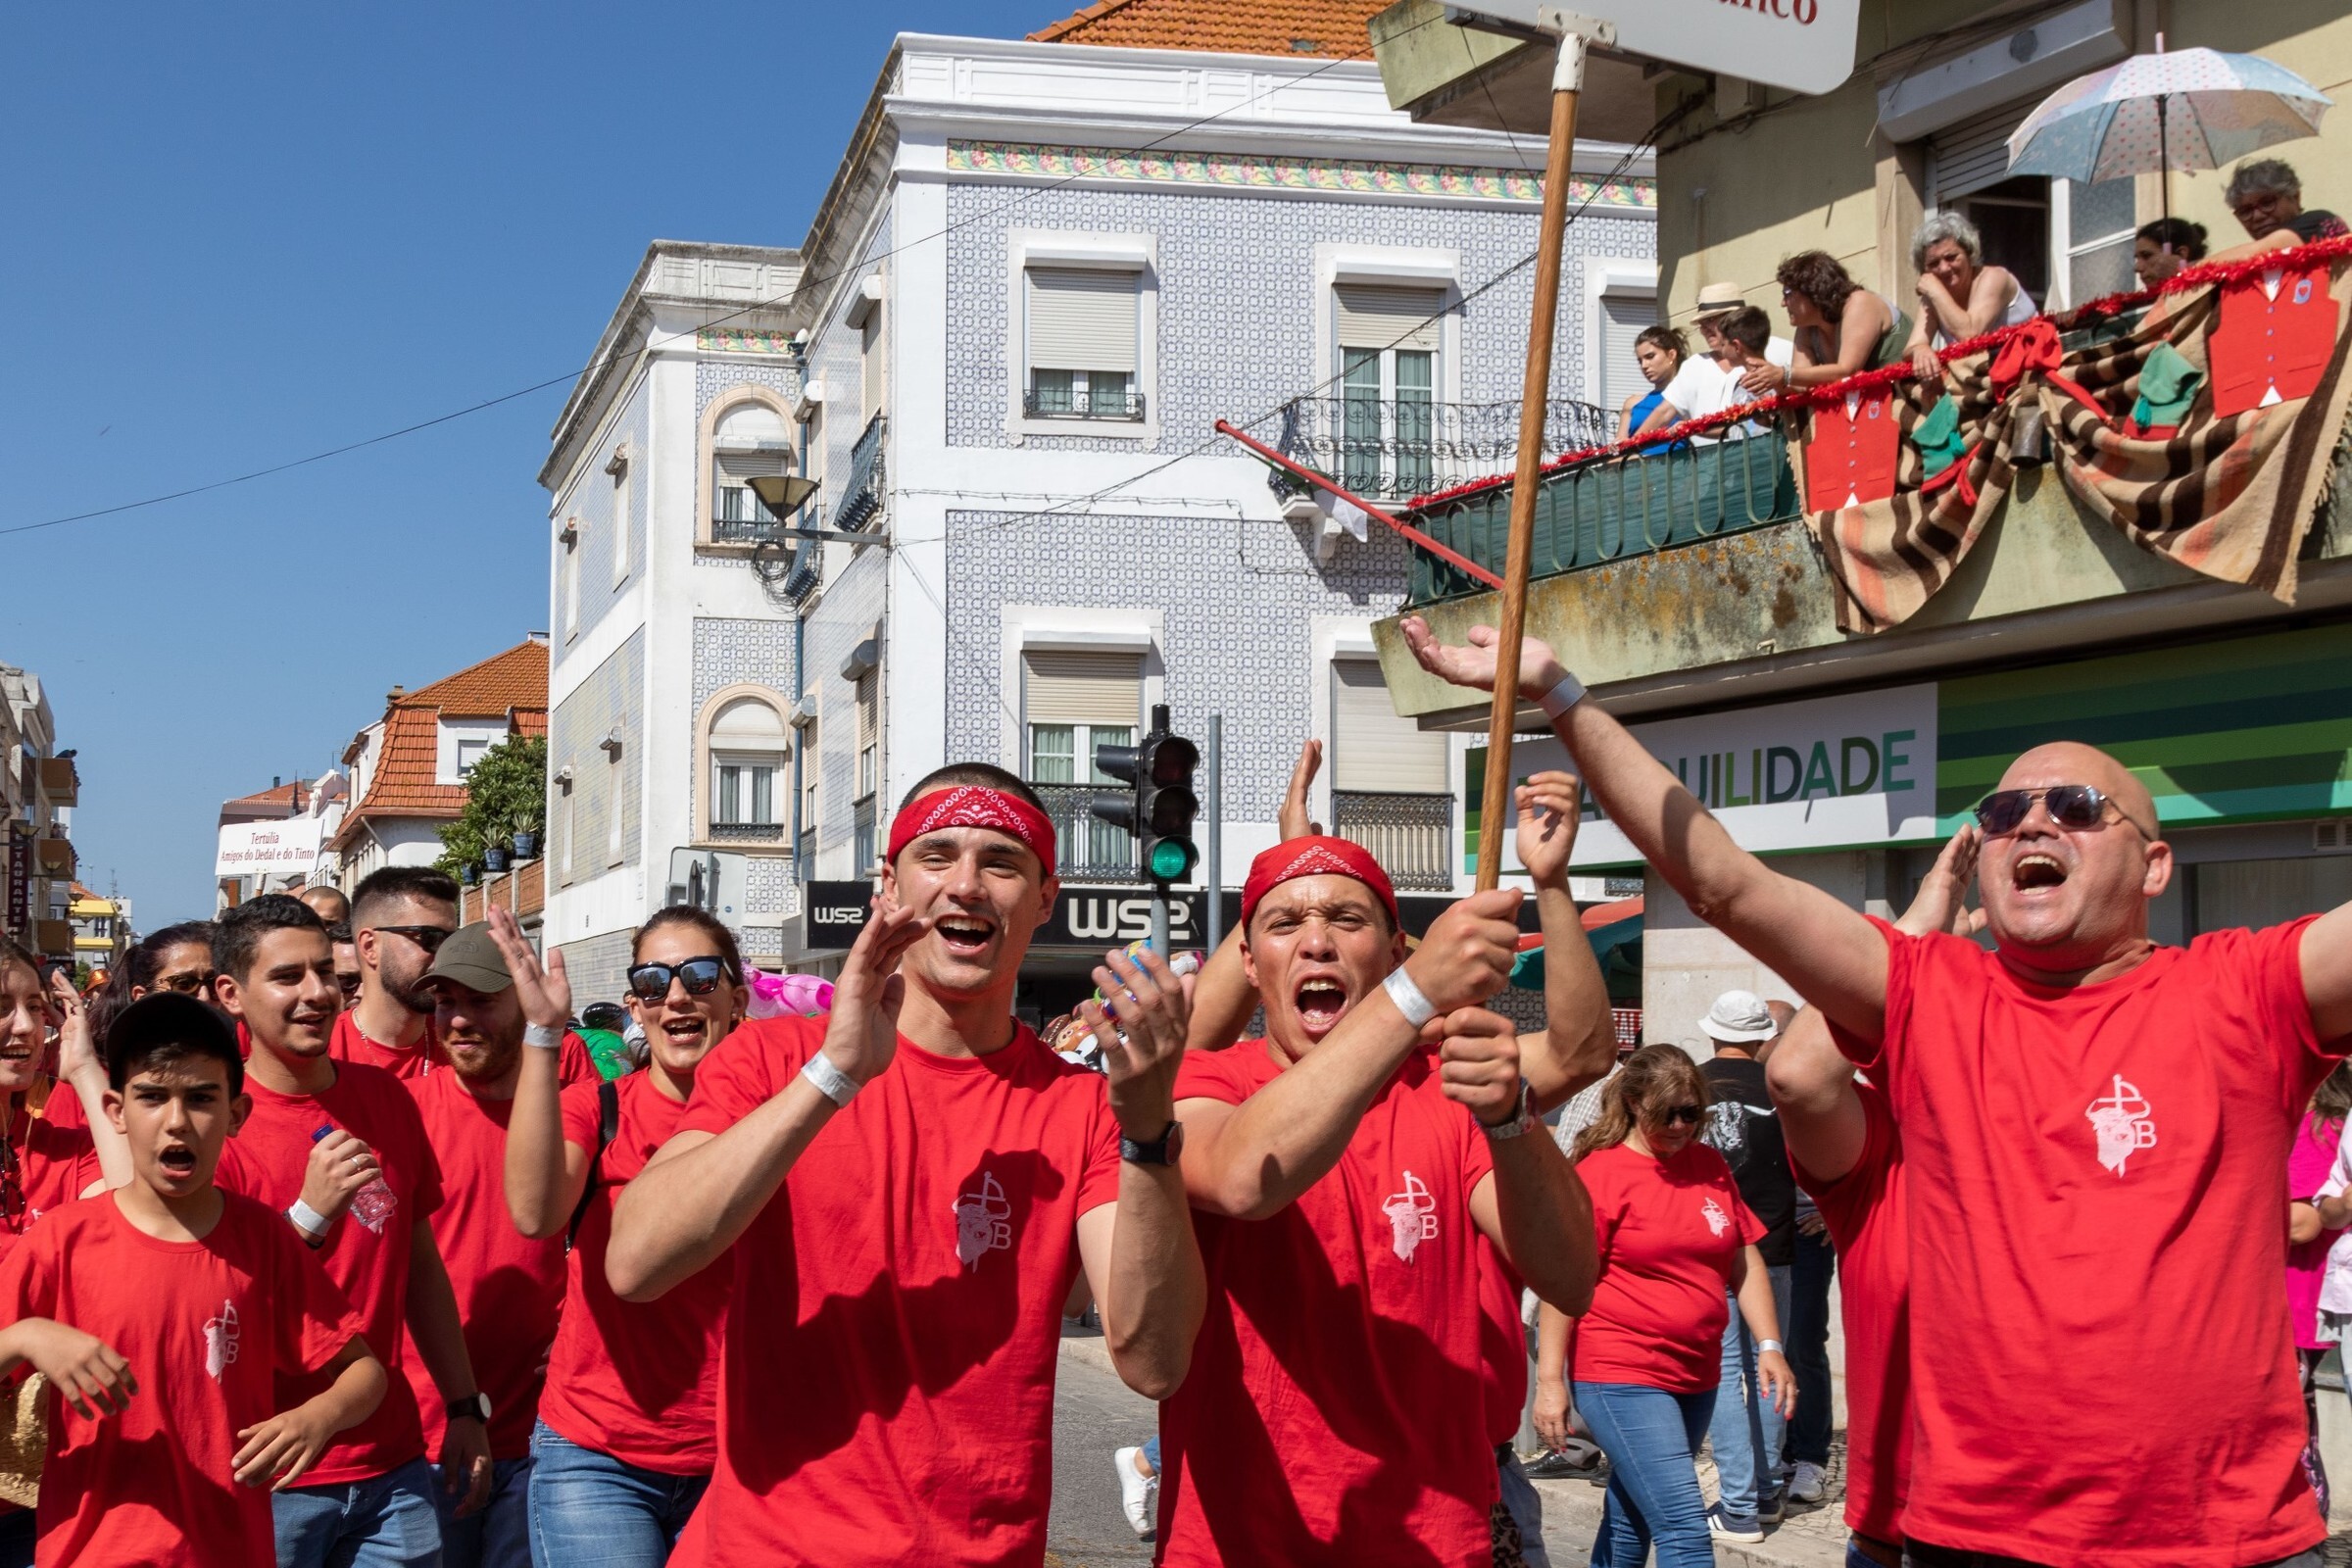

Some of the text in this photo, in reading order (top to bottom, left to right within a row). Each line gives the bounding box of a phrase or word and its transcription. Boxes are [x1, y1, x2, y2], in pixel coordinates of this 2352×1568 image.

[250, 830, 280, 845] Tertúlia
[220, 850, 244, 864] Amigos
[244, 849, 254, 860] do
[255, 848, 275, 860] Dedal
[283, 848, 293, 860] do
[295, 847, 316, 860] Tinto
